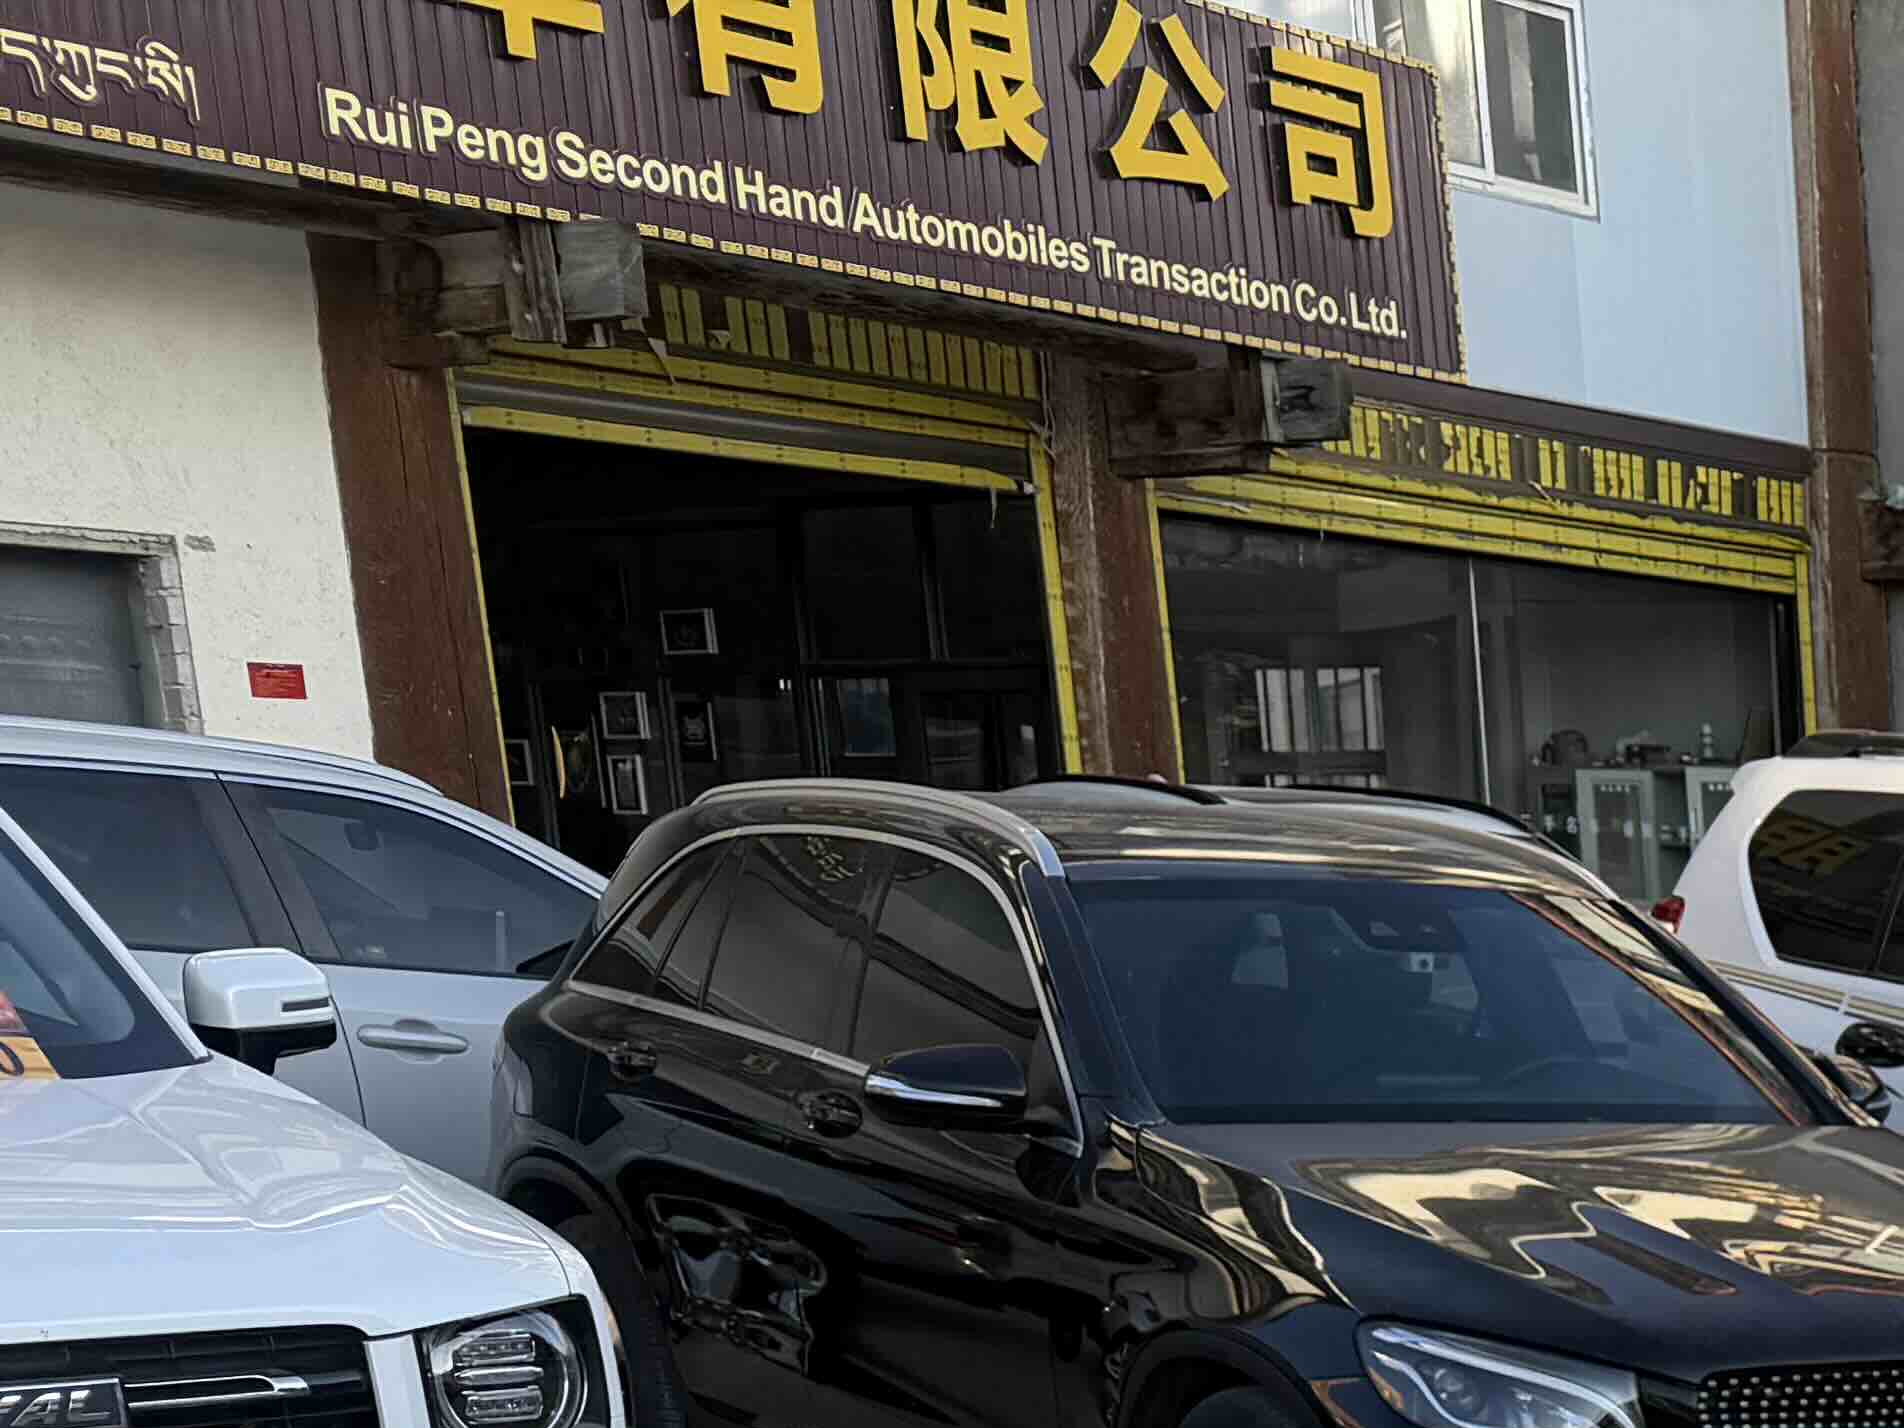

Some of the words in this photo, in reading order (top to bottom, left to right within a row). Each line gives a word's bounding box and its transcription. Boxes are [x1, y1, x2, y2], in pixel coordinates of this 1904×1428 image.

[324, 86, 412, 149] Rui
[420, 104, 549, 181] Peng
[555, 130, 727, 204] Second
[734, 165, 845, 229] Hand
[852, 191, 1090, 275] Automobiles
[1092, 236, 1291, 315] Transaction
[462, 0, 1394, 238] 有限公司
